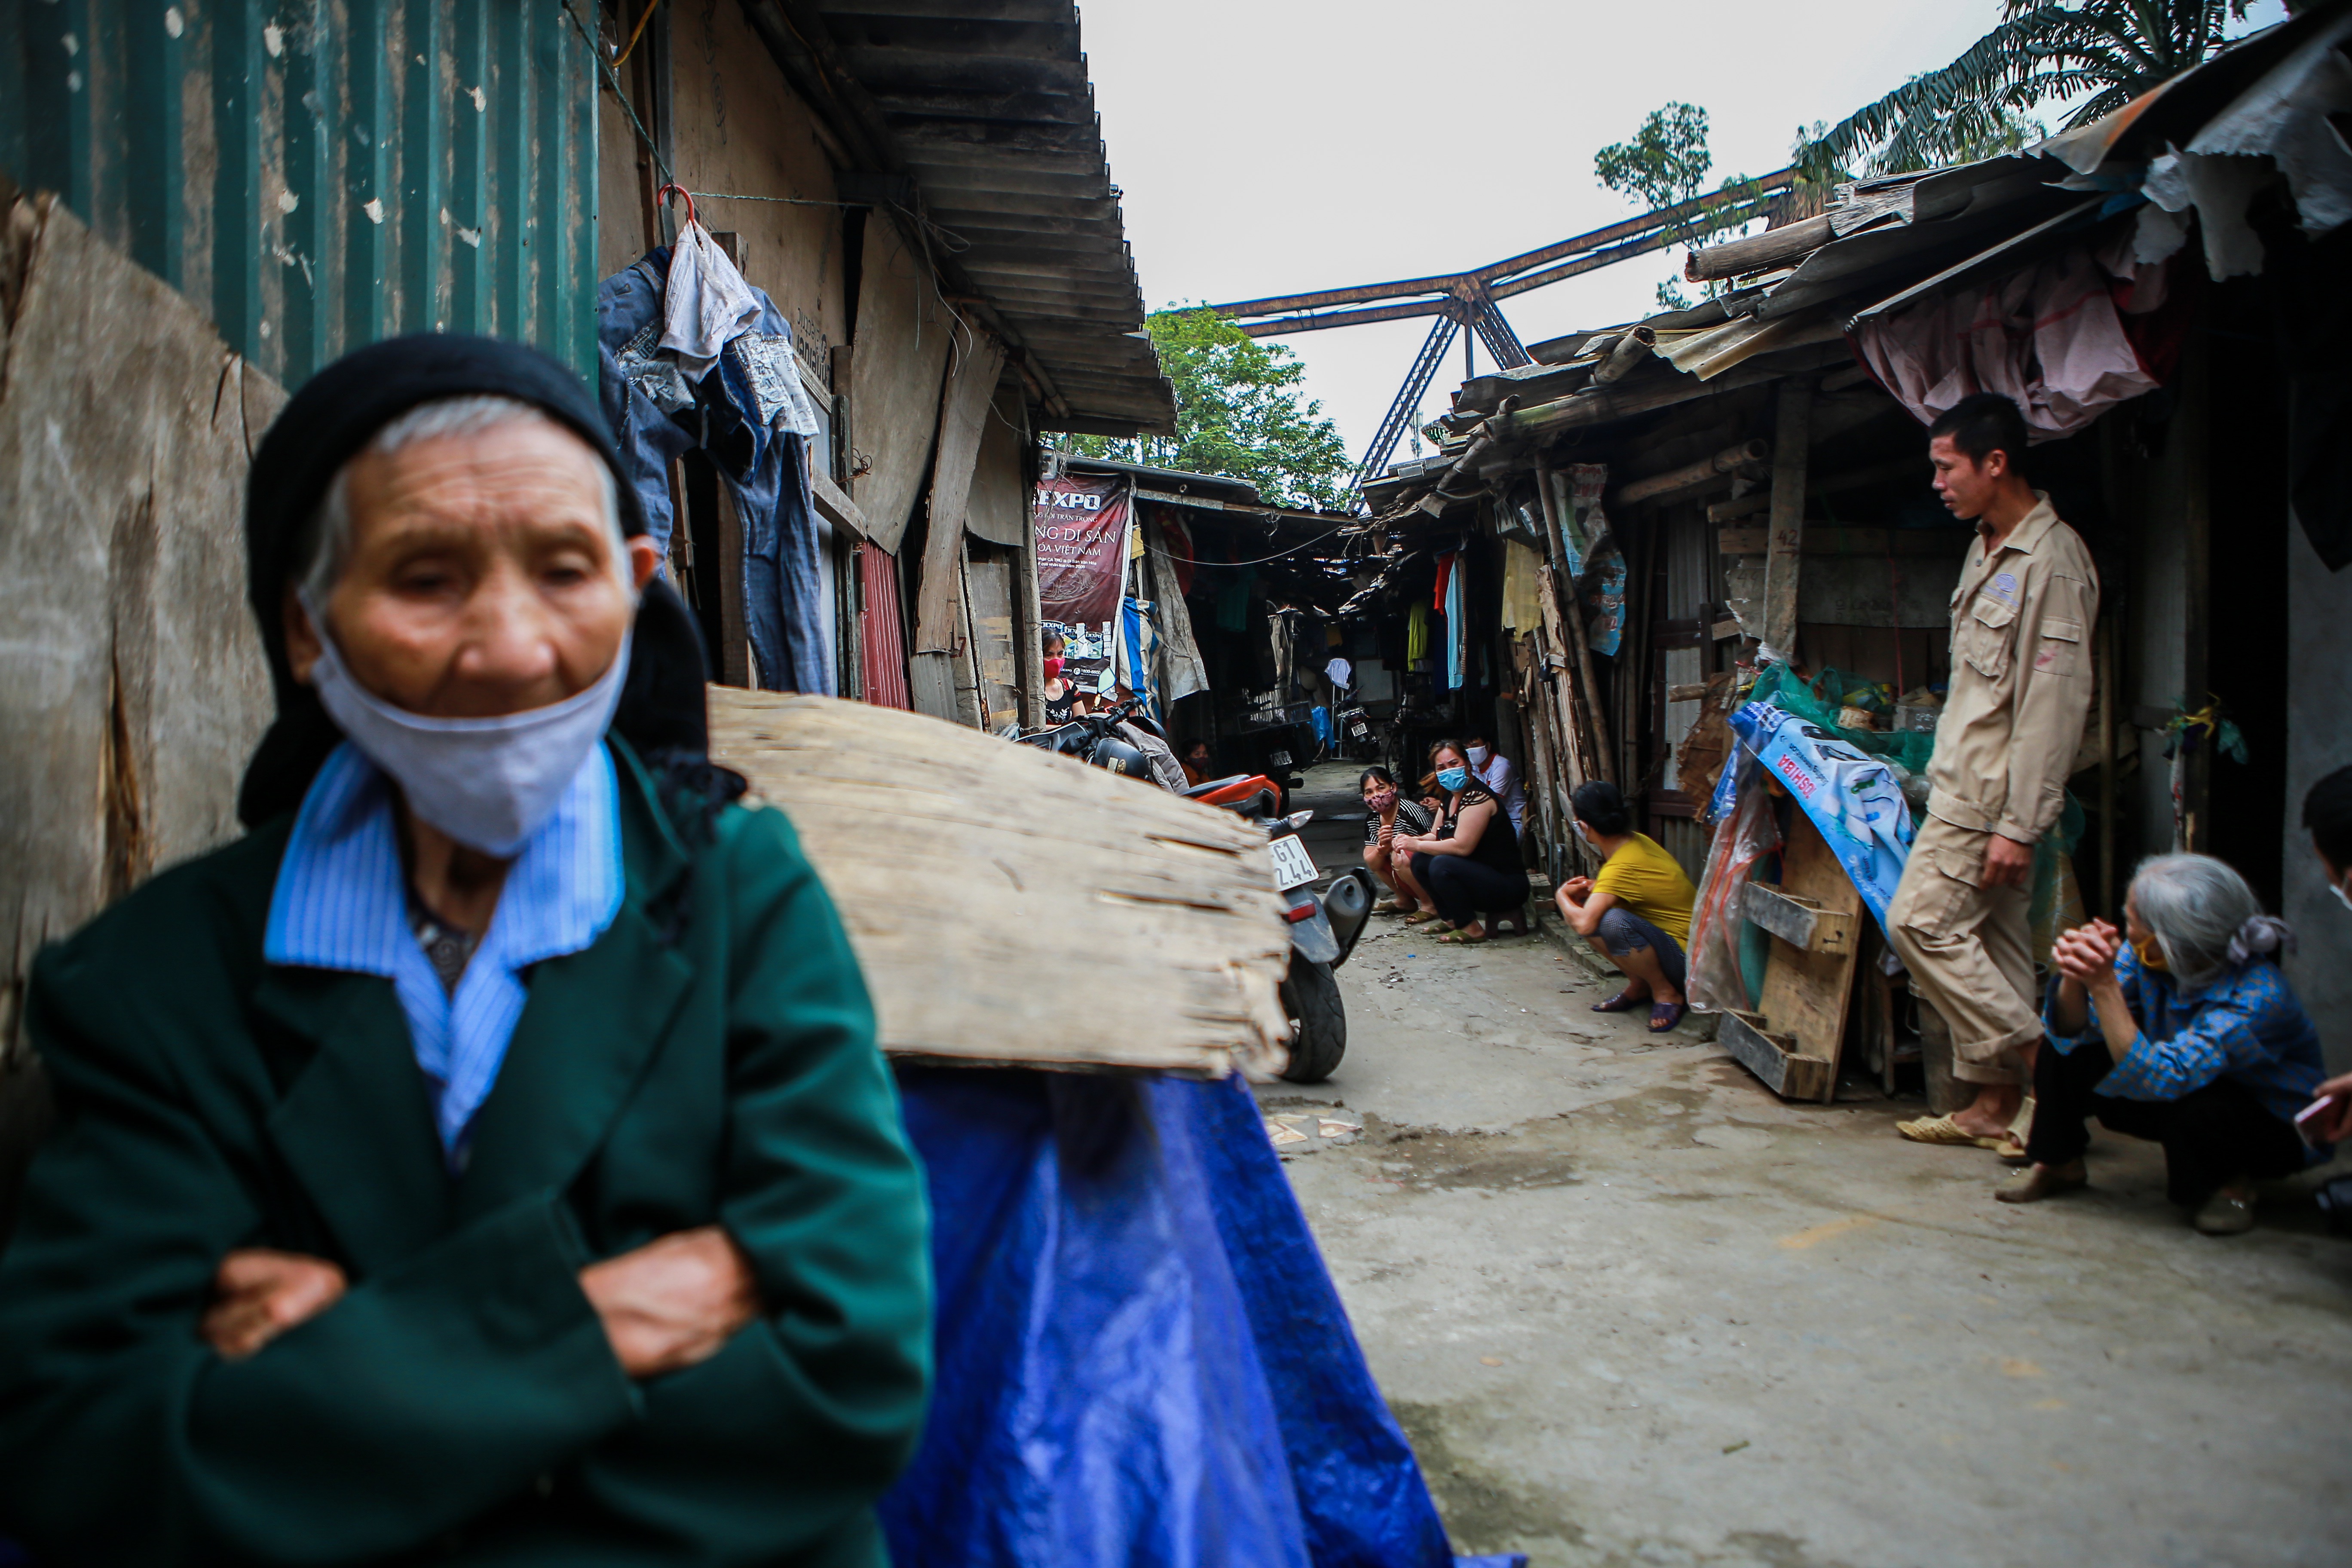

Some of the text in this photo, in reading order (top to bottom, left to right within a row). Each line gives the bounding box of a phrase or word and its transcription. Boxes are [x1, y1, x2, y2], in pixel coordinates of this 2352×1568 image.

[1033, 490, 1101, 511] EXPO
[1064, 528, 1081, 542] DI
[1085, 526, 1116, 544] SẢN
[1777, 529, 1798, 546] 42
[1054, 544, 1077, 555] VIỆT
[1078, 547, 1101, 556] NAM
[1777, 753, 1817, 799] TOSHIBA
